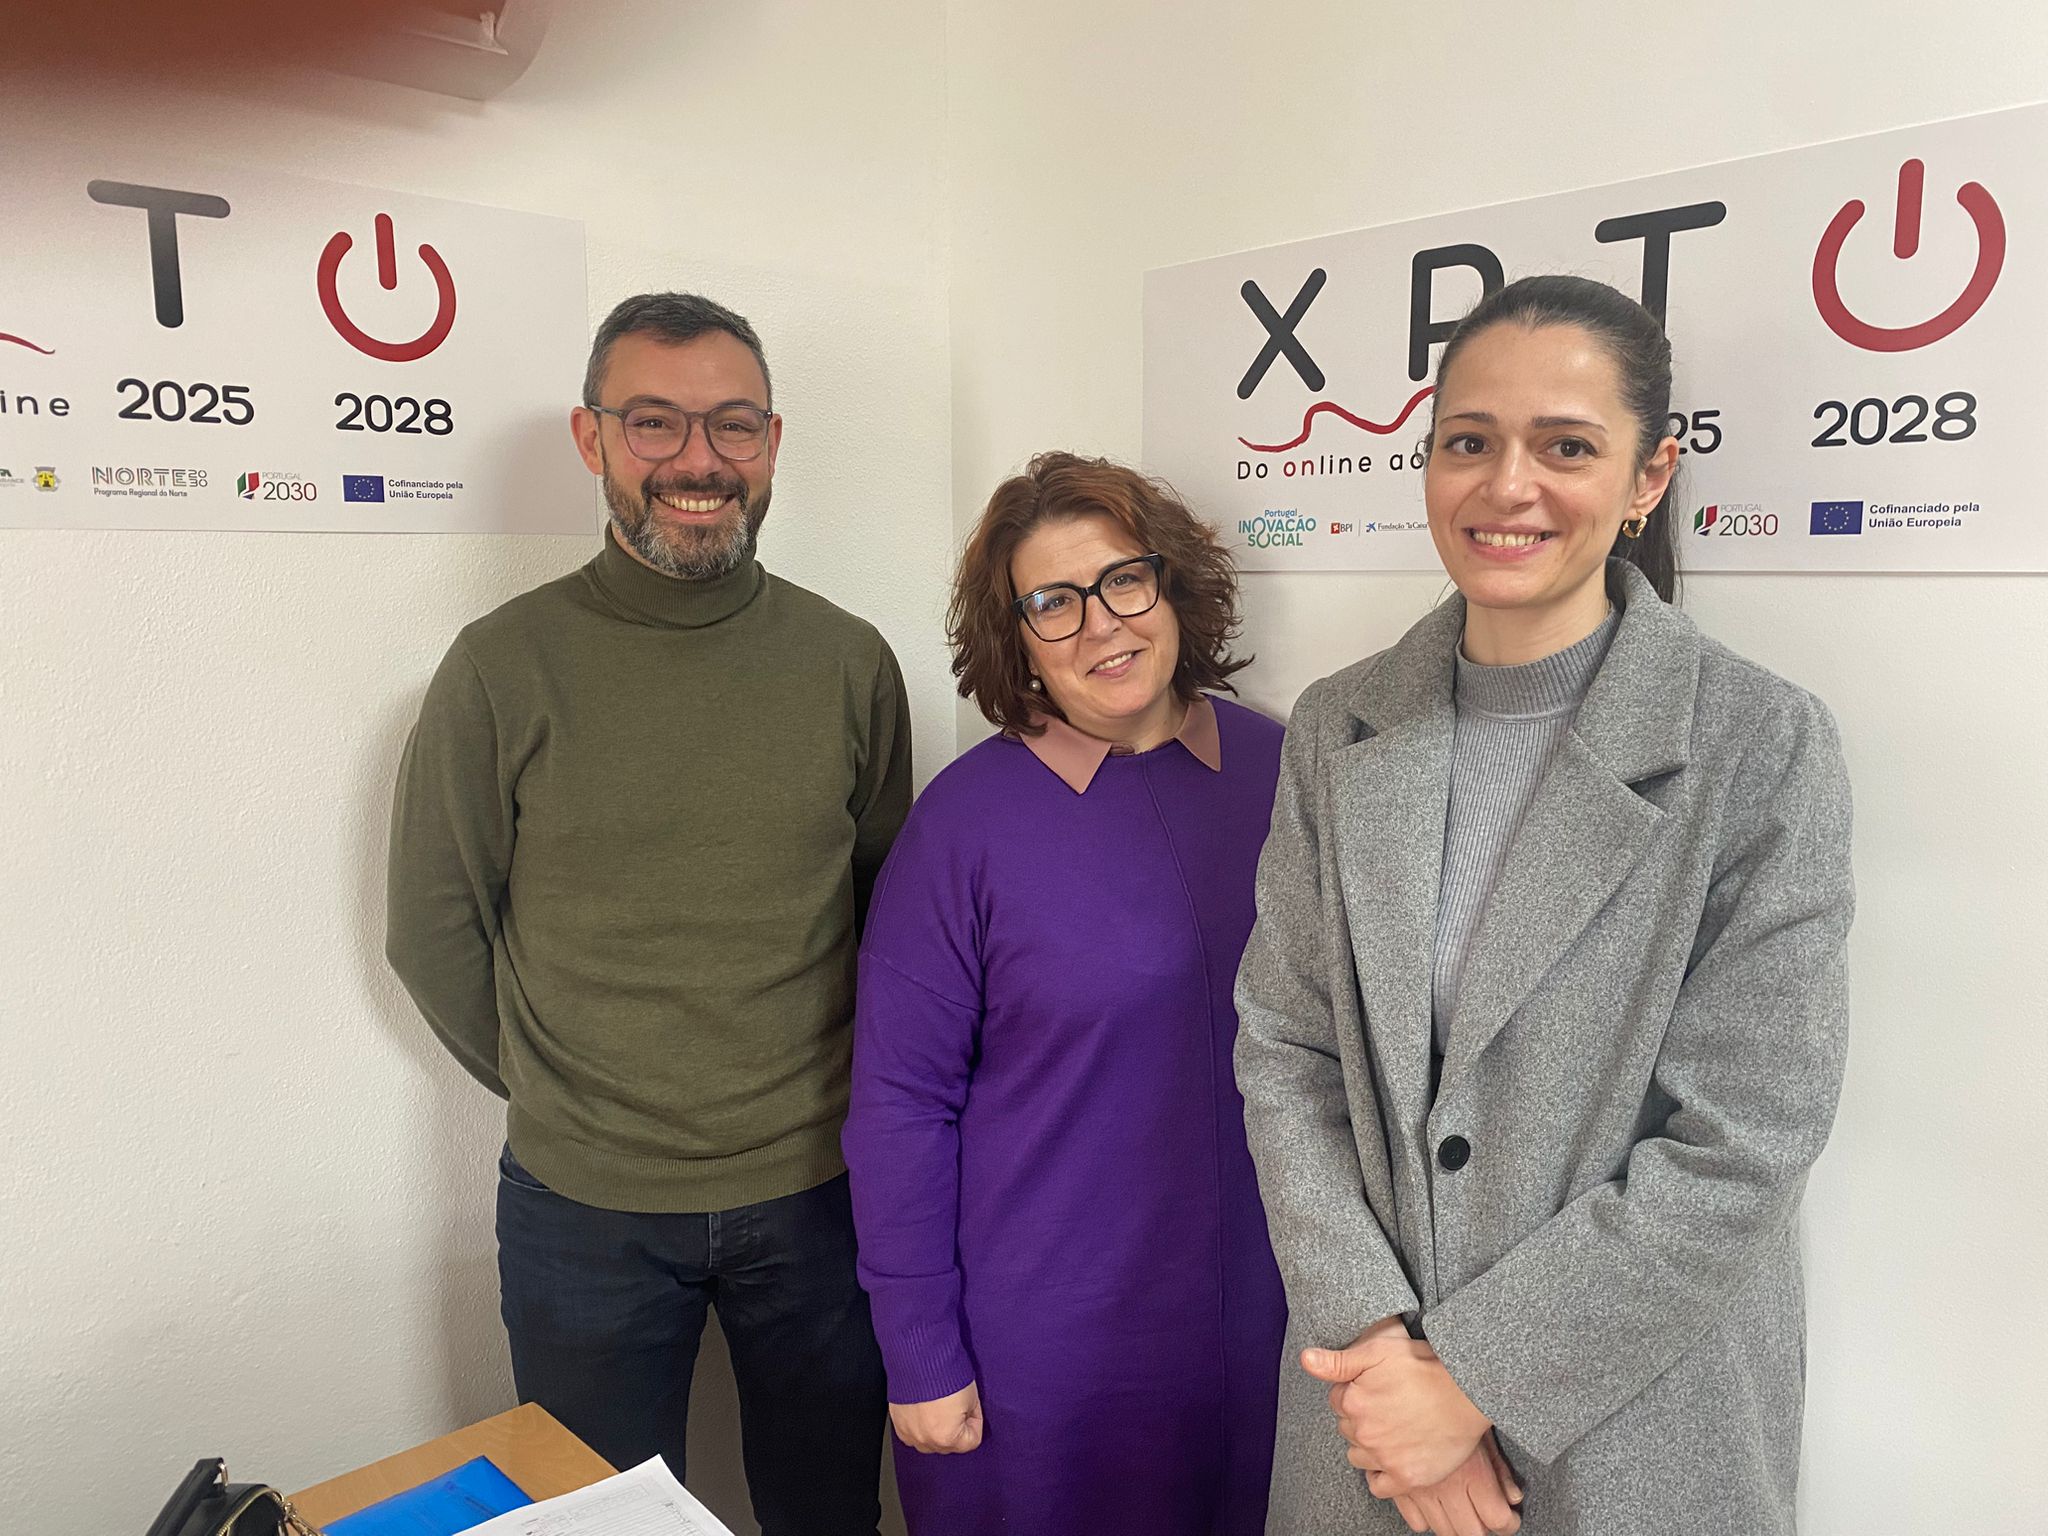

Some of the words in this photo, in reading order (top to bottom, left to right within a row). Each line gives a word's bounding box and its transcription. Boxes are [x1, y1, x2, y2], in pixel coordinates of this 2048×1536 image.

[116, 378, 255, 425] 2025
[335, 392, 454, 436] 2028
[1811, 391, 1978, 447] 2028
[1237, 461, 1268, 480] Do
[1283, 455, 1372, 477] online
[1389, 454, 1425, 470] ao
[92, 466, 187, 487] NORTE
[262, 471, 302, 481] PORTUGAL
[388, 479, 443, 489] Cofinanciado
[446, 482, 464, 490] pela
[94, 488, 127, 497] Programa
[129, 488, 158, 497] Regional
[169, 489, 187, 497] Norte
[262, 481, 317, 501] 2030
[389, 490, 414, 499] União
[416, 491, 453, 500] Europeia
[1264, 508, 1297, 518] Portugal
[1720, 503, 1763, 512] PORTUGAL
[1869, 503, 1950, 515] Cofinanciado
[1953, 502, 1980, 514] pela
[1340, 523, 1353, 533] BPI
[1378, 522, 1404, 530] Fundação
[1719, 514, 1778, 536] 2030
[1868, 517, 1903, 528] União
[1906, 517, 1962, 529] Europeia
[1248, 532, 1303, 549] SOCIAL
